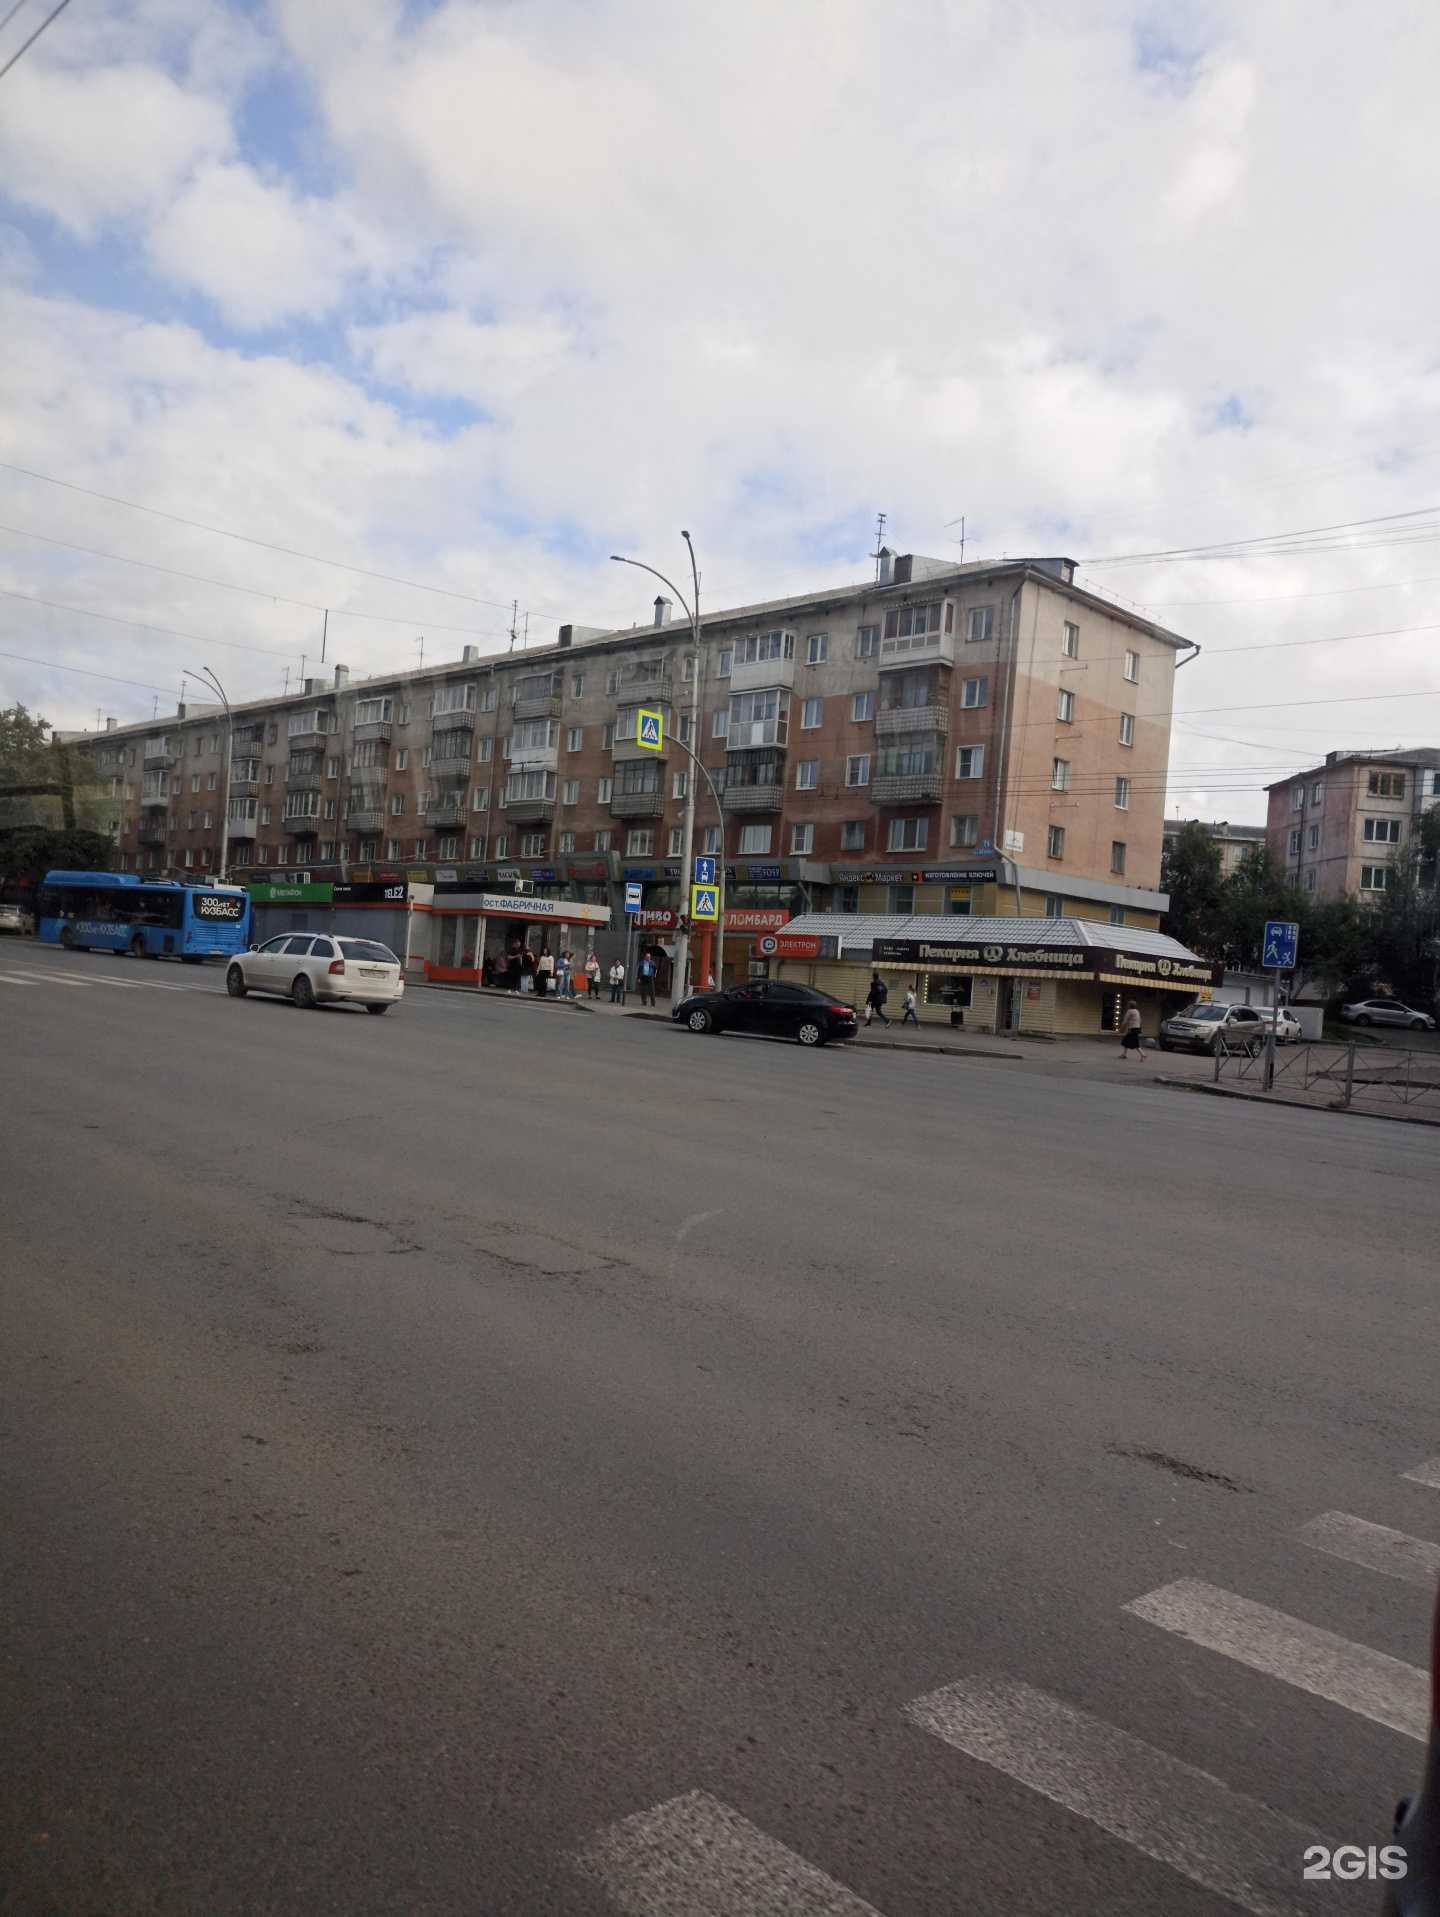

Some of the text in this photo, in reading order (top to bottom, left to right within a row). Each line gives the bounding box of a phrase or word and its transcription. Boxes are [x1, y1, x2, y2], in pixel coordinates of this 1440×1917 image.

[875, 871, 904, 883] Маркет
[384, 886, 404, 899] TELE2
[201, 897, 219, 906] 300
[201, 906, 239, 917] КУЗБАСС
[730, 913, 783, 926] ЛОМБАРД
[780, 940, 817, 950] ЭЛЕКТРОН
[919, 944, 980, 962] Пекарня
[1006, 947, 1084, 967] Хлебница
